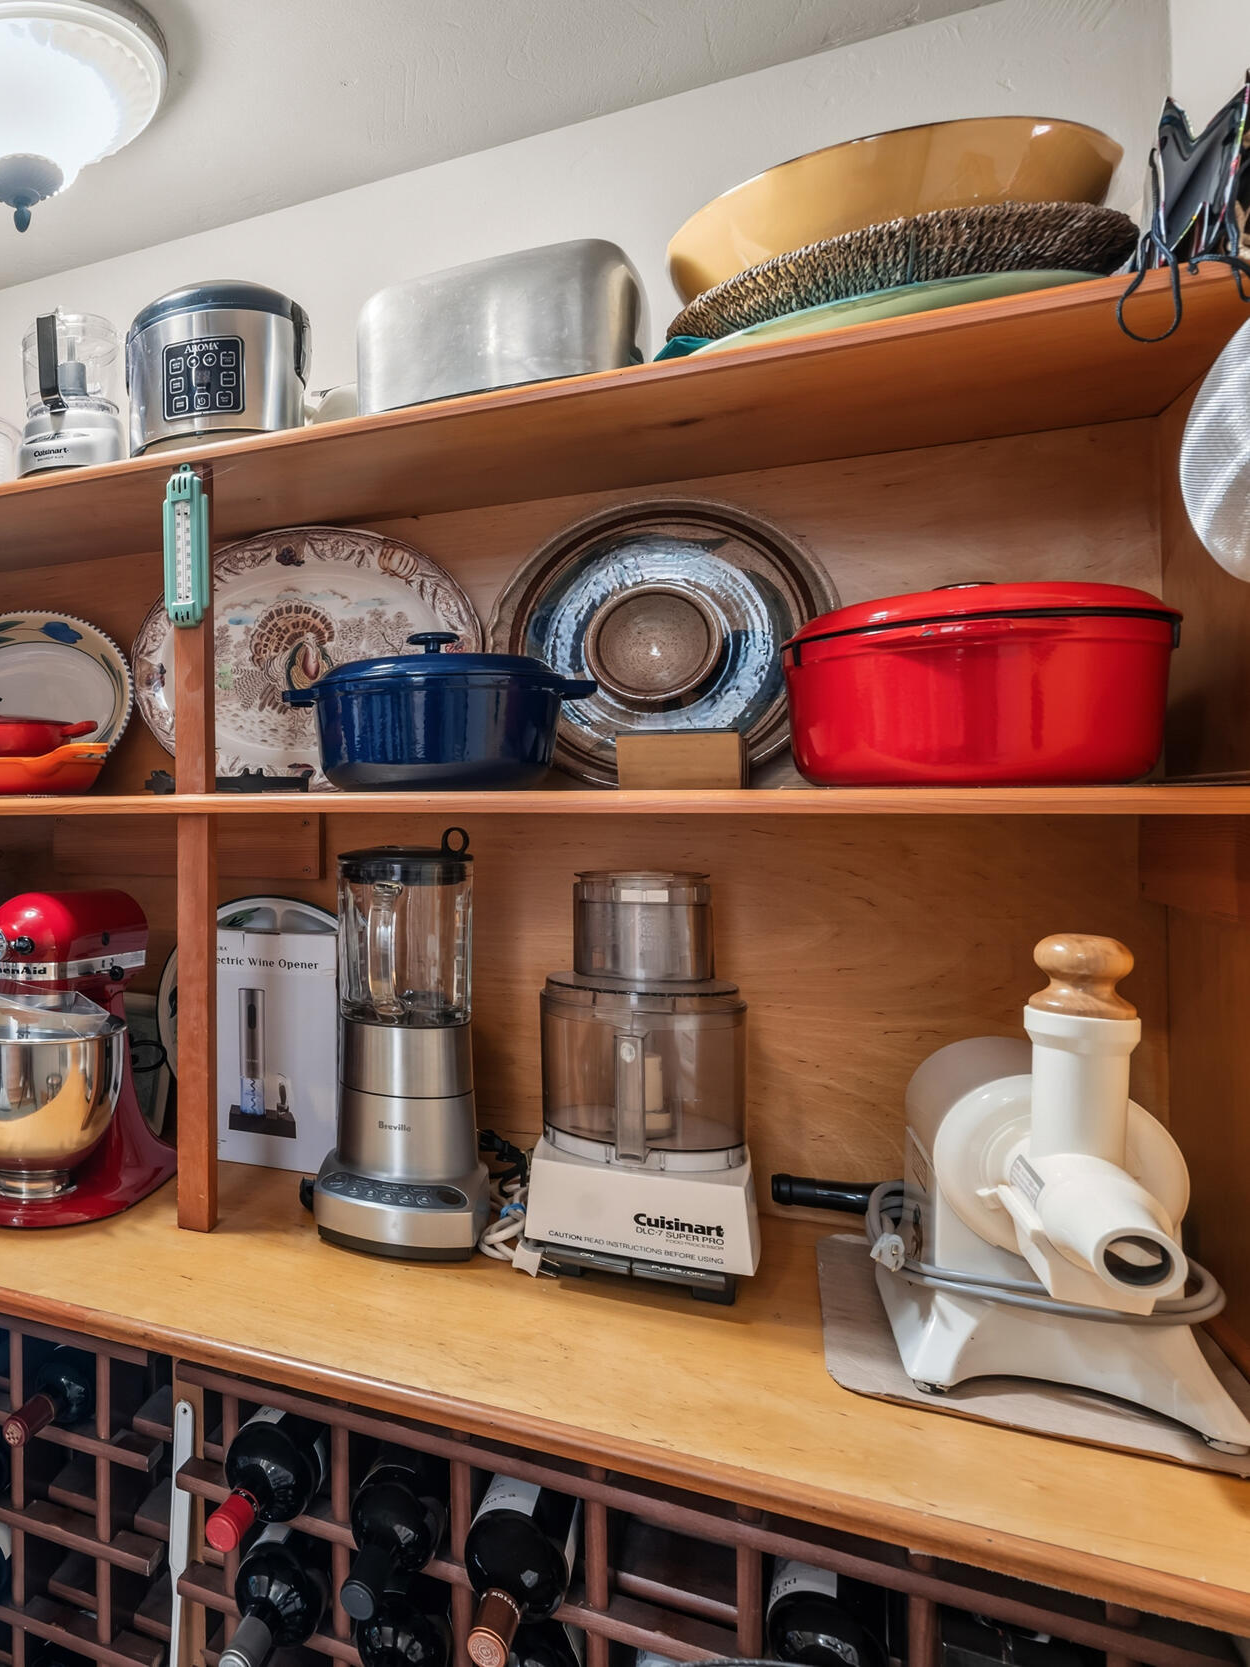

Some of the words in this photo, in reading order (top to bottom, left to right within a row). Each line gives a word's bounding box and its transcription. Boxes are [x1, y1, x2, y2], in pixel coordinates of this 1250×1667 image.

[184, 342, 219, 354] AROMA
[33, 446, 70, 458] Cuisinart
[248, 956, 275, 968] Wine
[278, 958, 319, 971] Opener
[378, 1121, 412, 1133] Breville
[633, 1212, 725, 1238] Cuisinart
[636, 1226, 664, 1239] DLC-7
[665, 1230, 700, 1243] SUPER
[701, 1235, 725, 1246] PRO
[584, 1236, 605, 1246] READ
[606, 1240, 663, 1256] INSTRUCTIONS
[664, 1249, 696, 1261] BEFORE
[697, 1254, 724, 1265] USING
[665, 1238, 685, 1246] FOOD
[686, 1241, 725, 1251] PROCESSOR
[580, 1251, 595, 1259] ON
